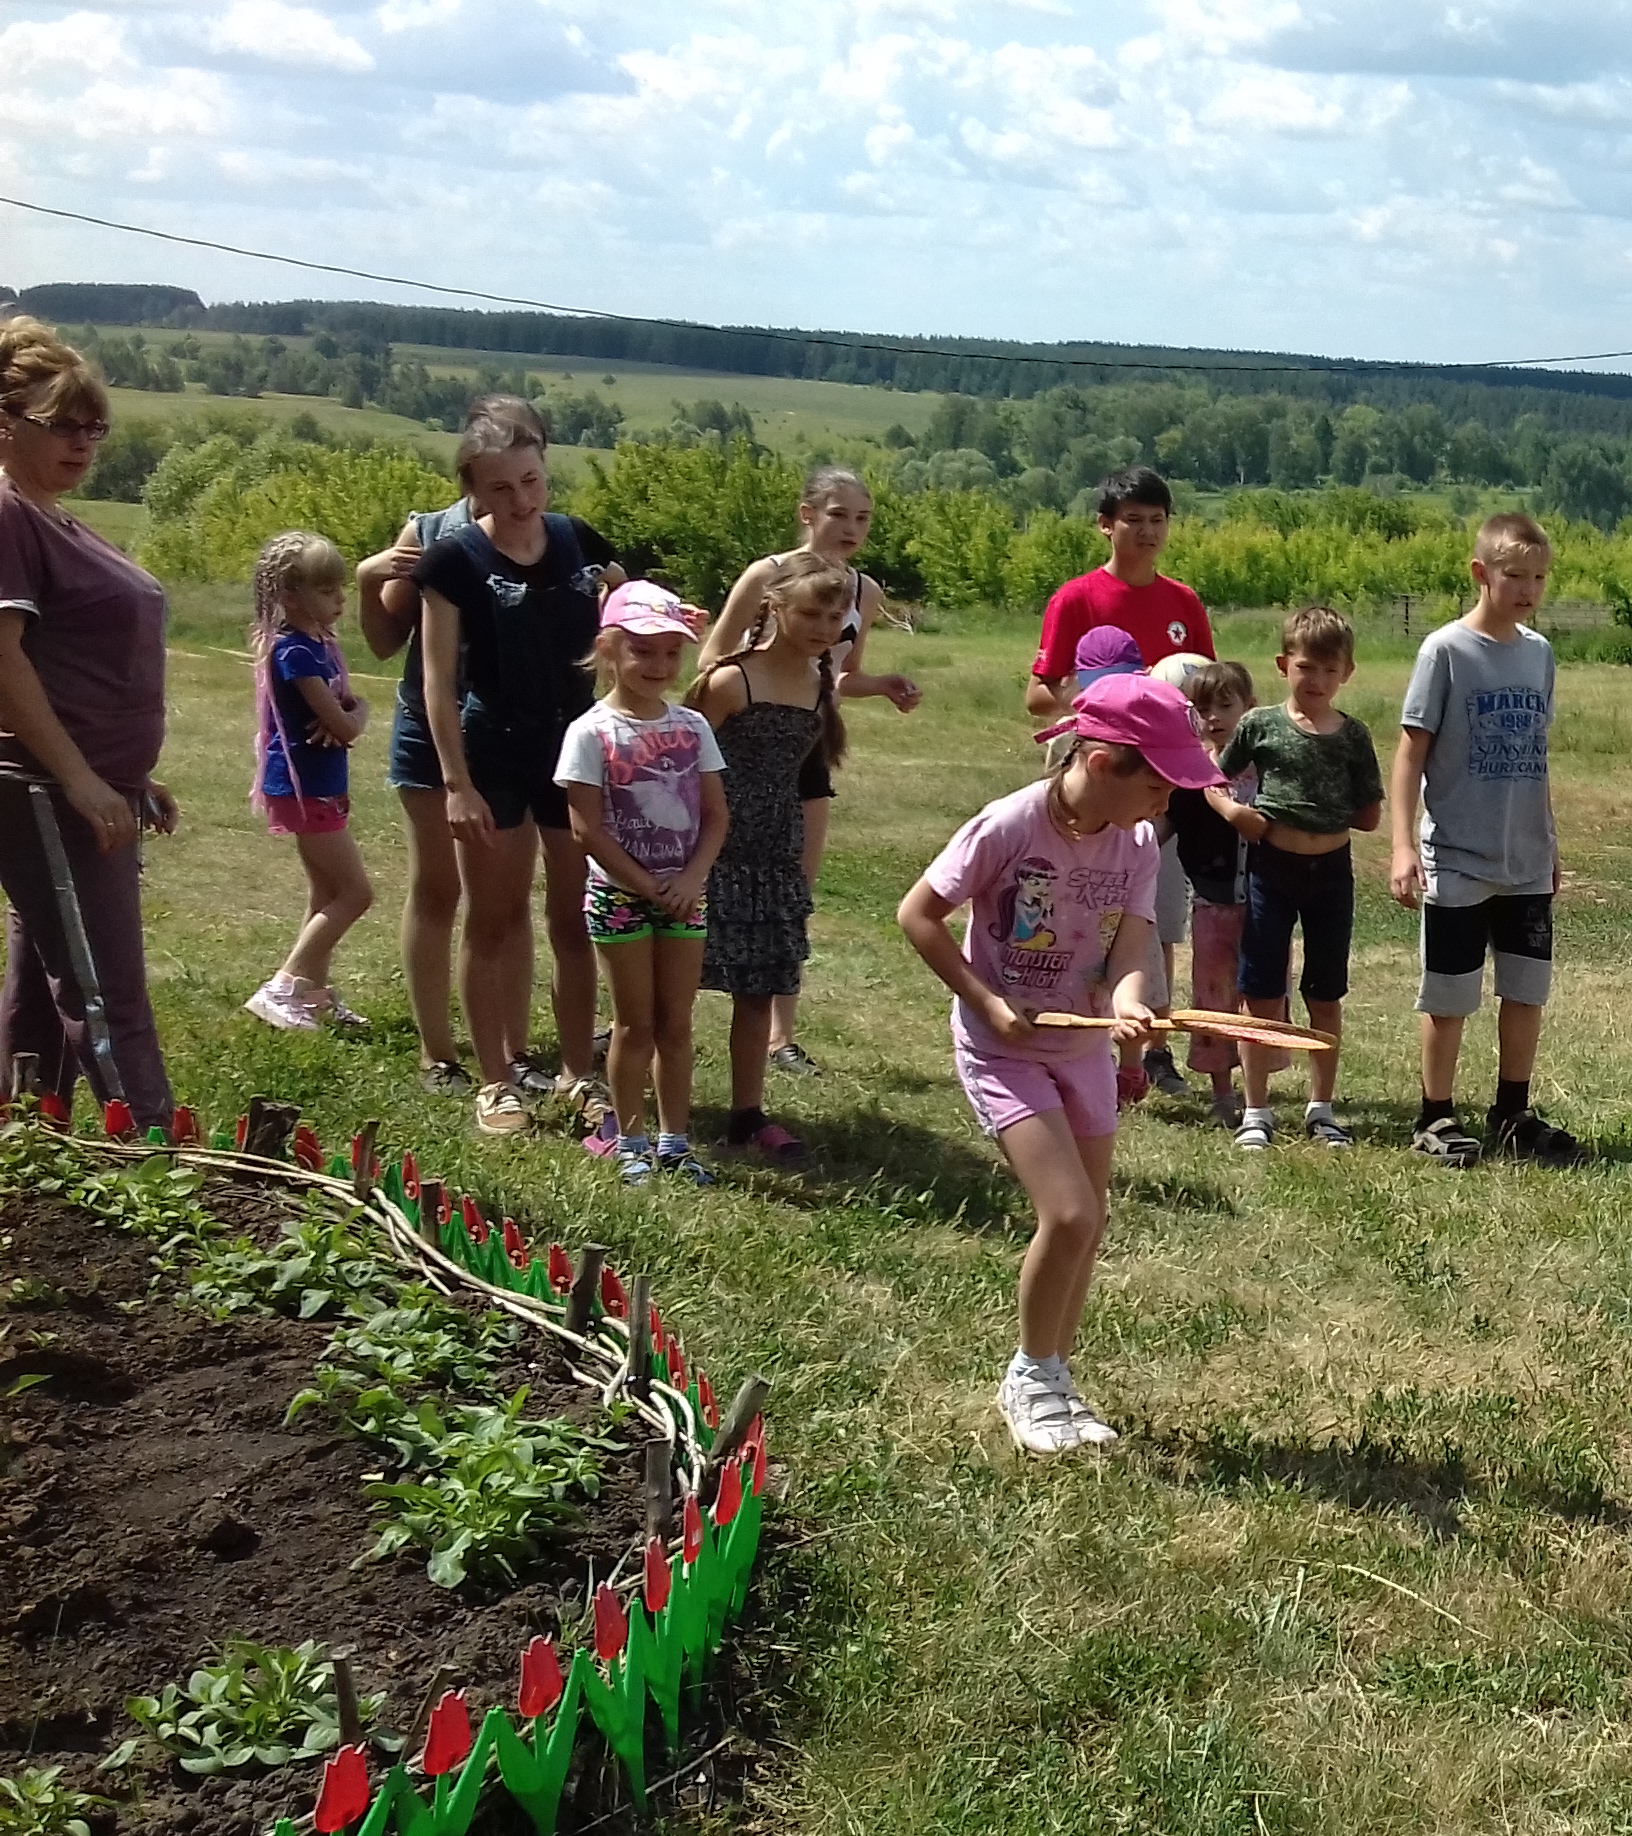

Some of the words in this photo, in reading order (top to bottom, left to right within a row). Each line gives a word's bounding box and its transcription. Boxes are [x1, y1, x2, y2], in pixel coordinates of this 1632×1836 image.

[1477, 692, 1545, 715] MARCH
[1004, 949, 1071, 969] MONSTER
[1020, 966, 1060, 986] HIGH
